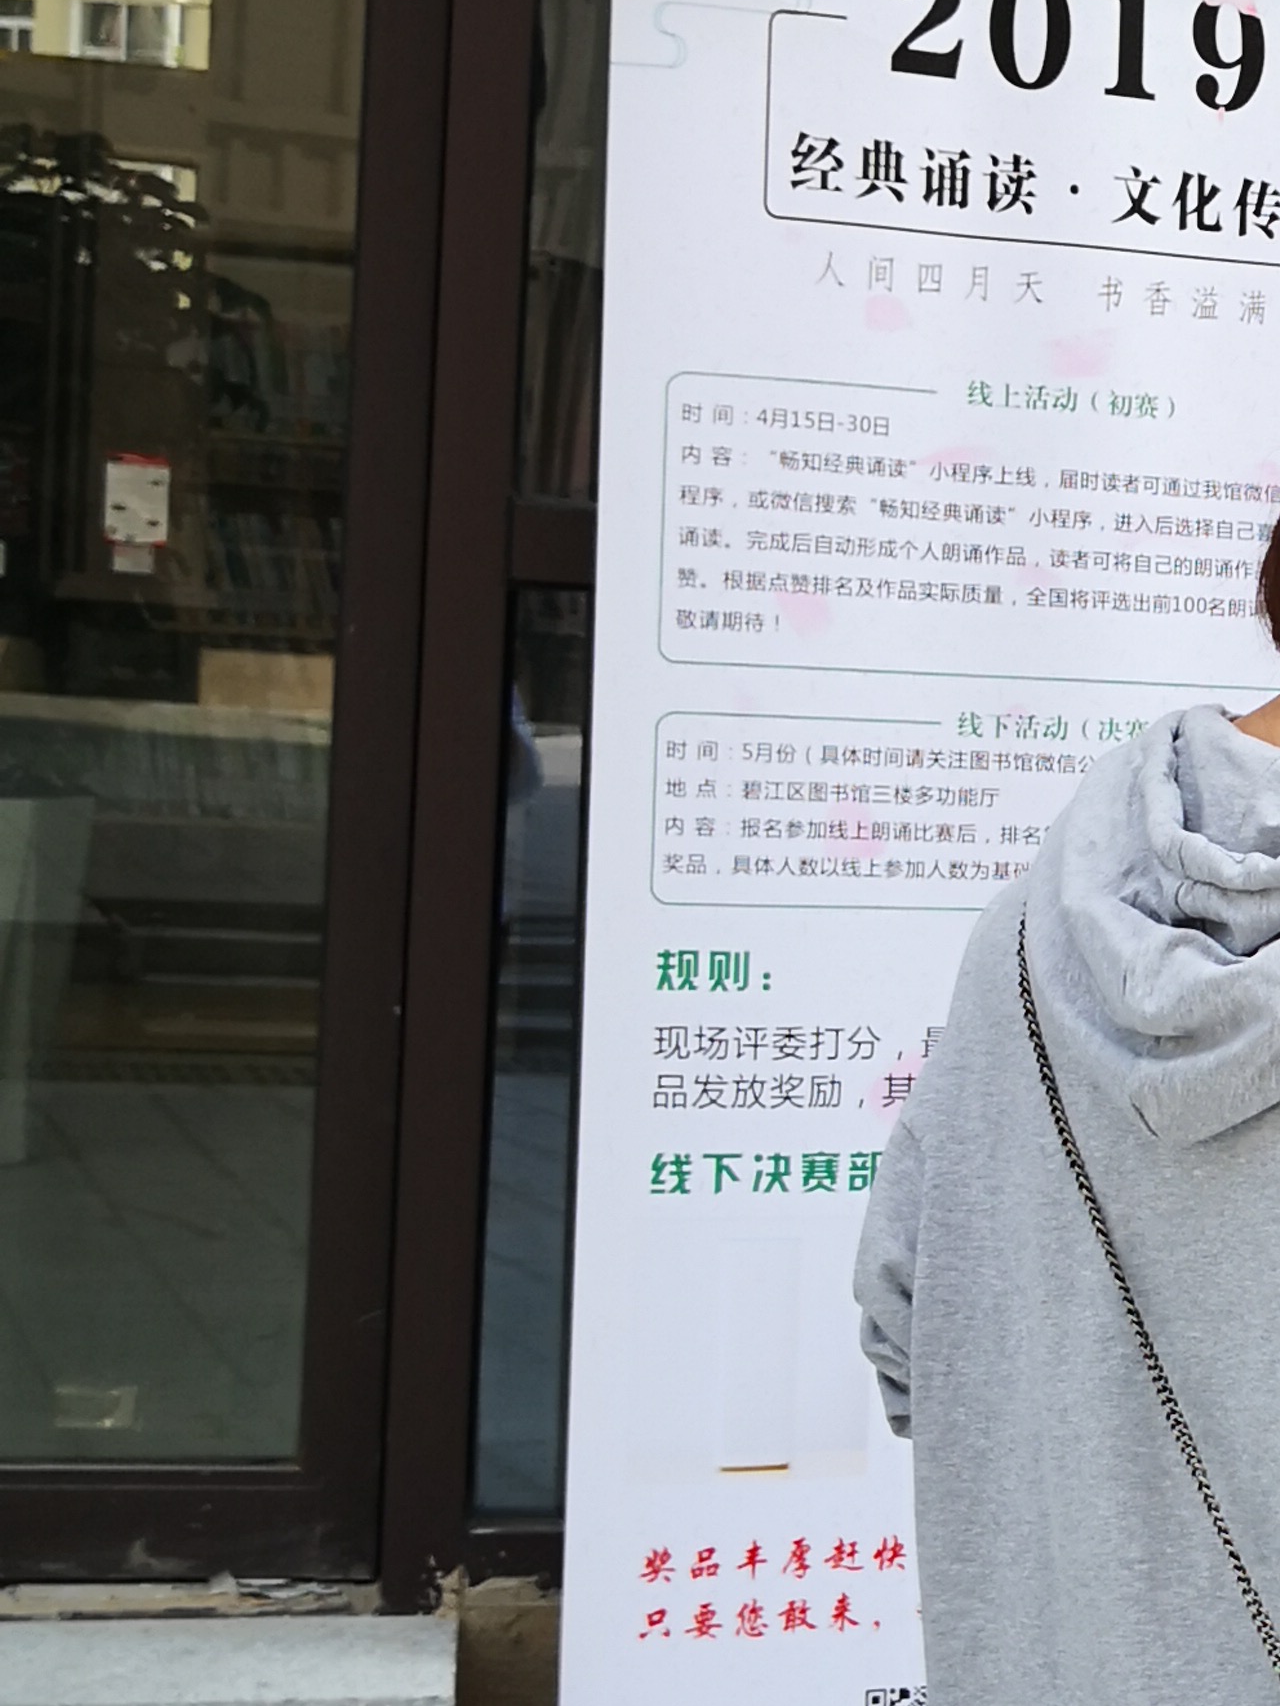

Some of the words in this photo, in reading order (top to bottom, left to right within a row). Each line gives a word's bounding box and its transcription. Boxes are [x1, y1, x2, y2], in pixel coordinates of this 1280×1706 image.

[676, 609, 782, 635] 敬请期待！
[656, 950, 773, 992] 规则：
[637, 1535, 907, 1584] 奖品丰厚赶快
